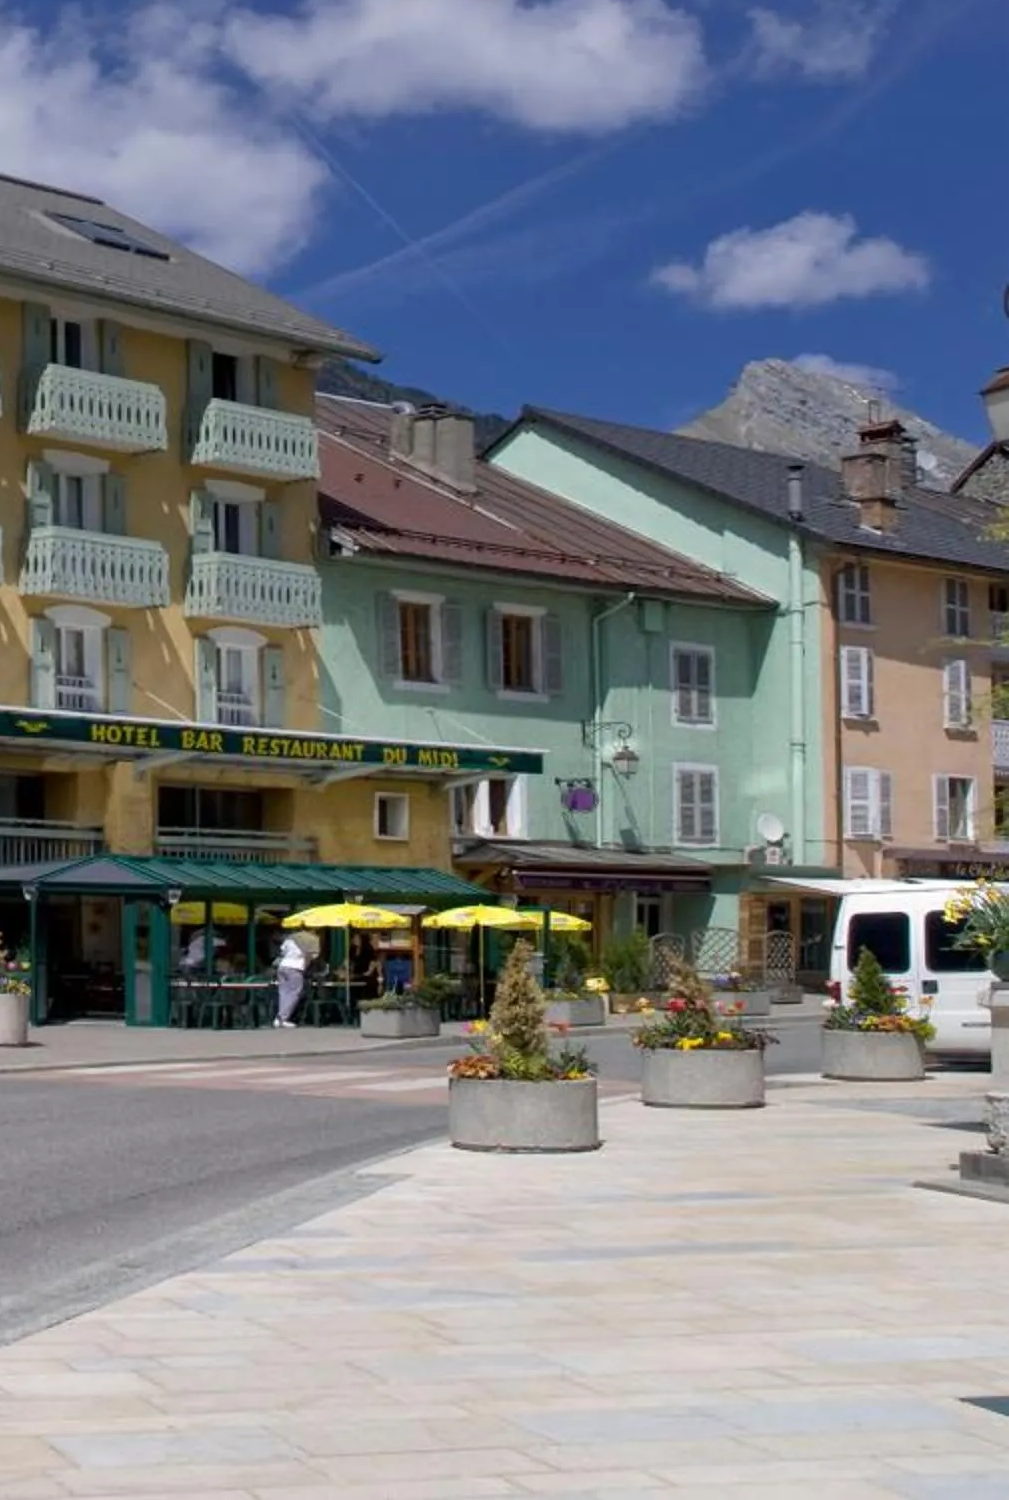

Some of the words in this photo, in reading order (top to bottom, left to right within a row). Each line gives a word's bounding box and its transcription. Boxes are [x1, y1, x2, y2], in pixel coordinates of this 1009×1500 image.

[91, 723, 160, 748] HOTEL
[182, 729, 223, 753] BAR
[242, 735, 364, 762] RESTAURANT
[382, 746, 407, 765] DU
[417, 748, 460, 768] MIDI
